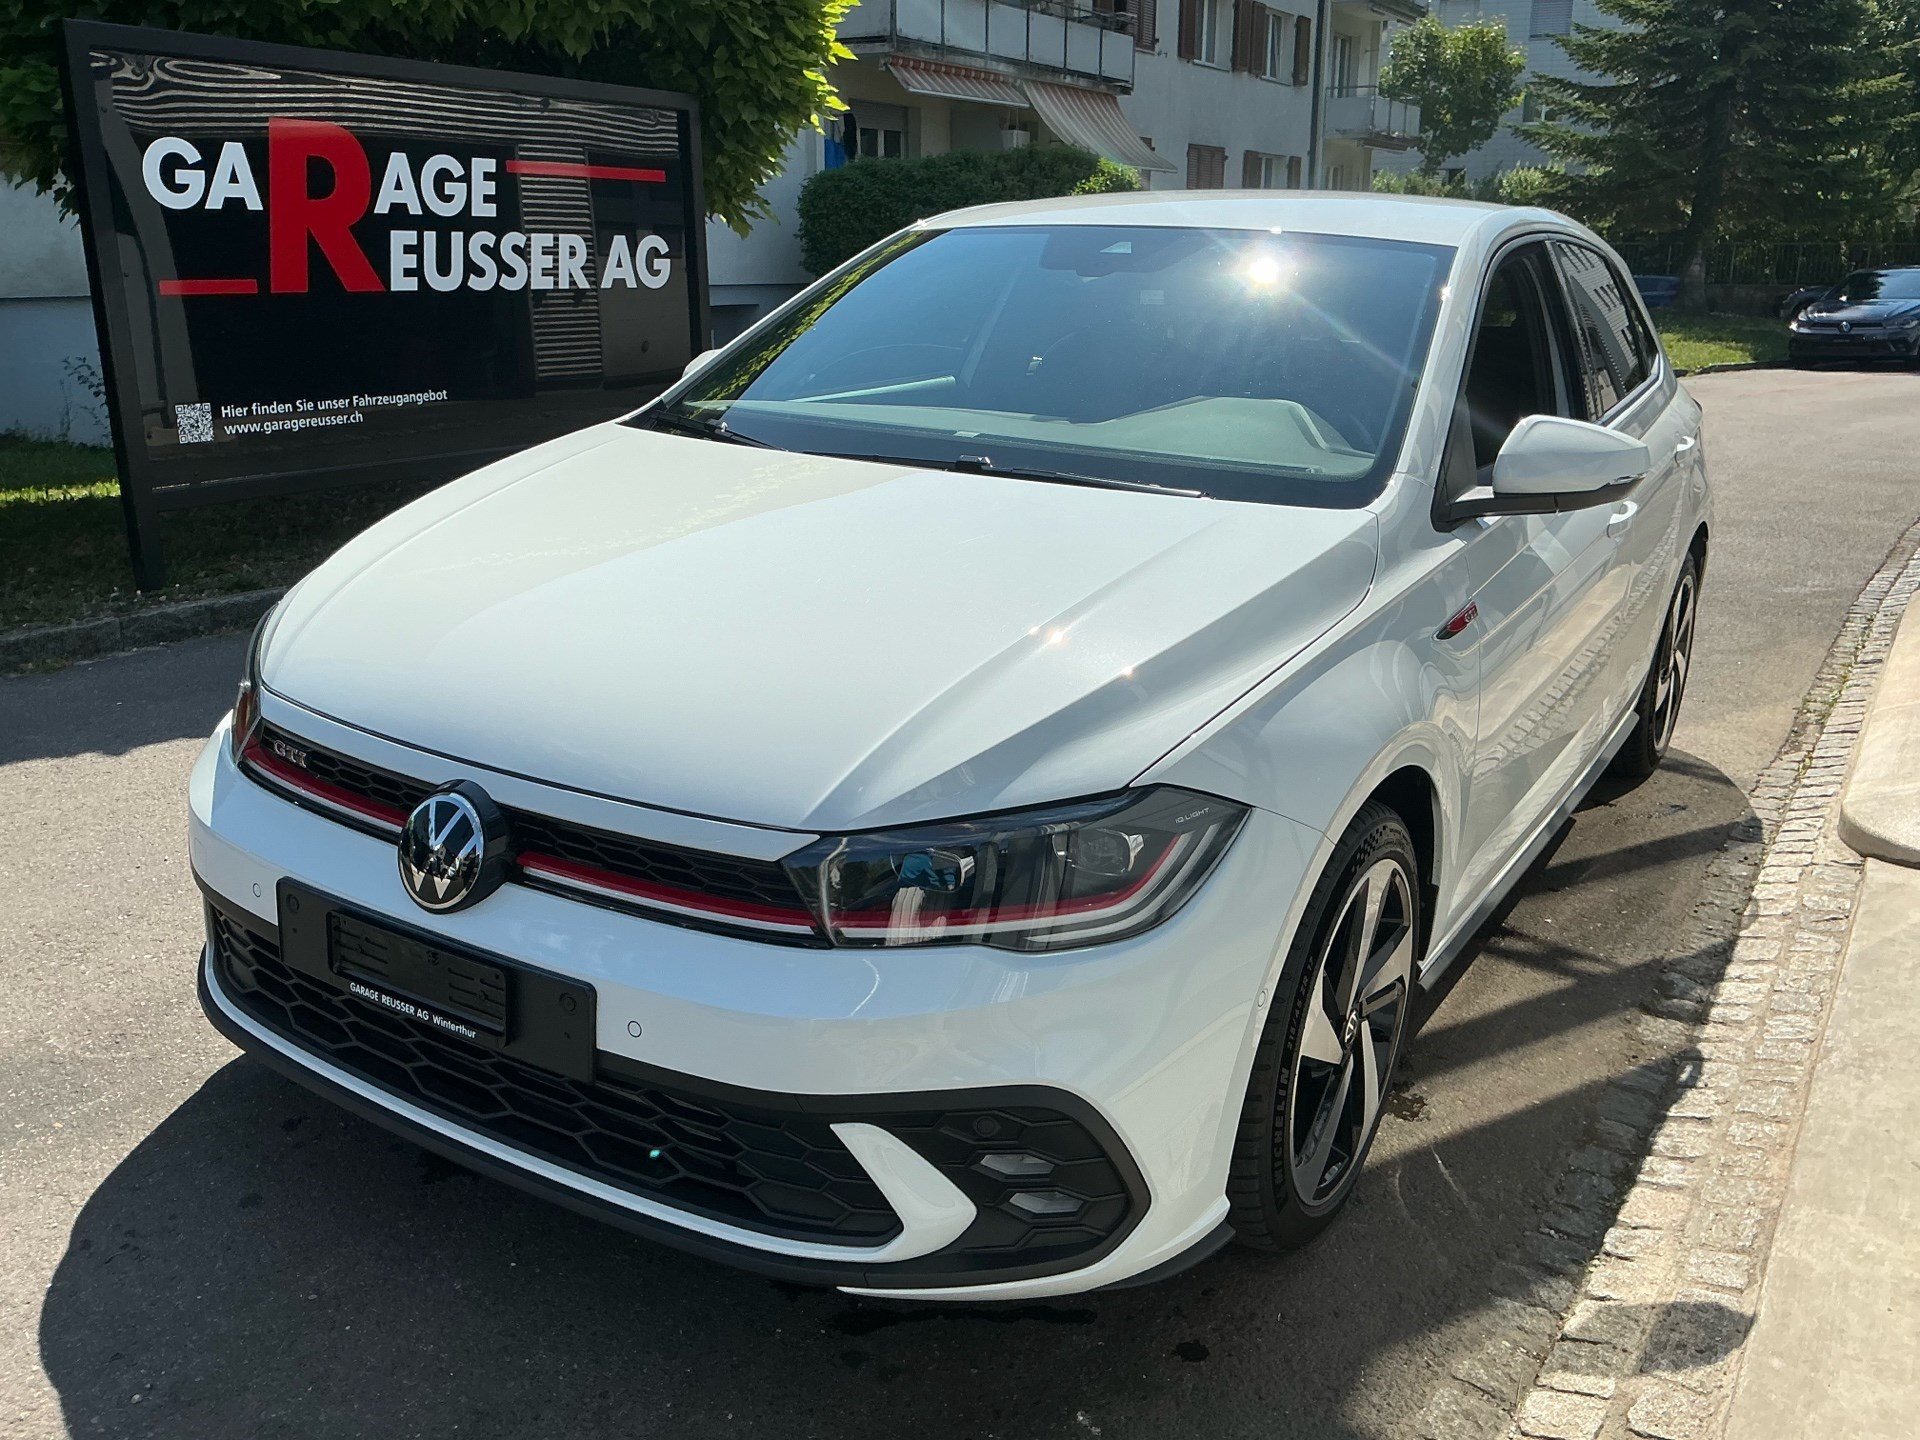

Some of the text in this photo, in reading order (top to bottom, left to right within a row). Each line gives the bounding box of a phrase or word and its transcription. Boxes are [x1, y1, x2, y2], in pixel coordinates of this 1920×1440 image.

[600, 234, 671, 289] AG
[221, 389, 448, 418] Hier finden Sie unser Fahrzeugangebot
[224, 411, 363, 434] www.garagereusser.ch
[273, 739, 308, 769] GTI
[350, 982, 476, 1038] GARAGE REUSSER AG Winterthur
